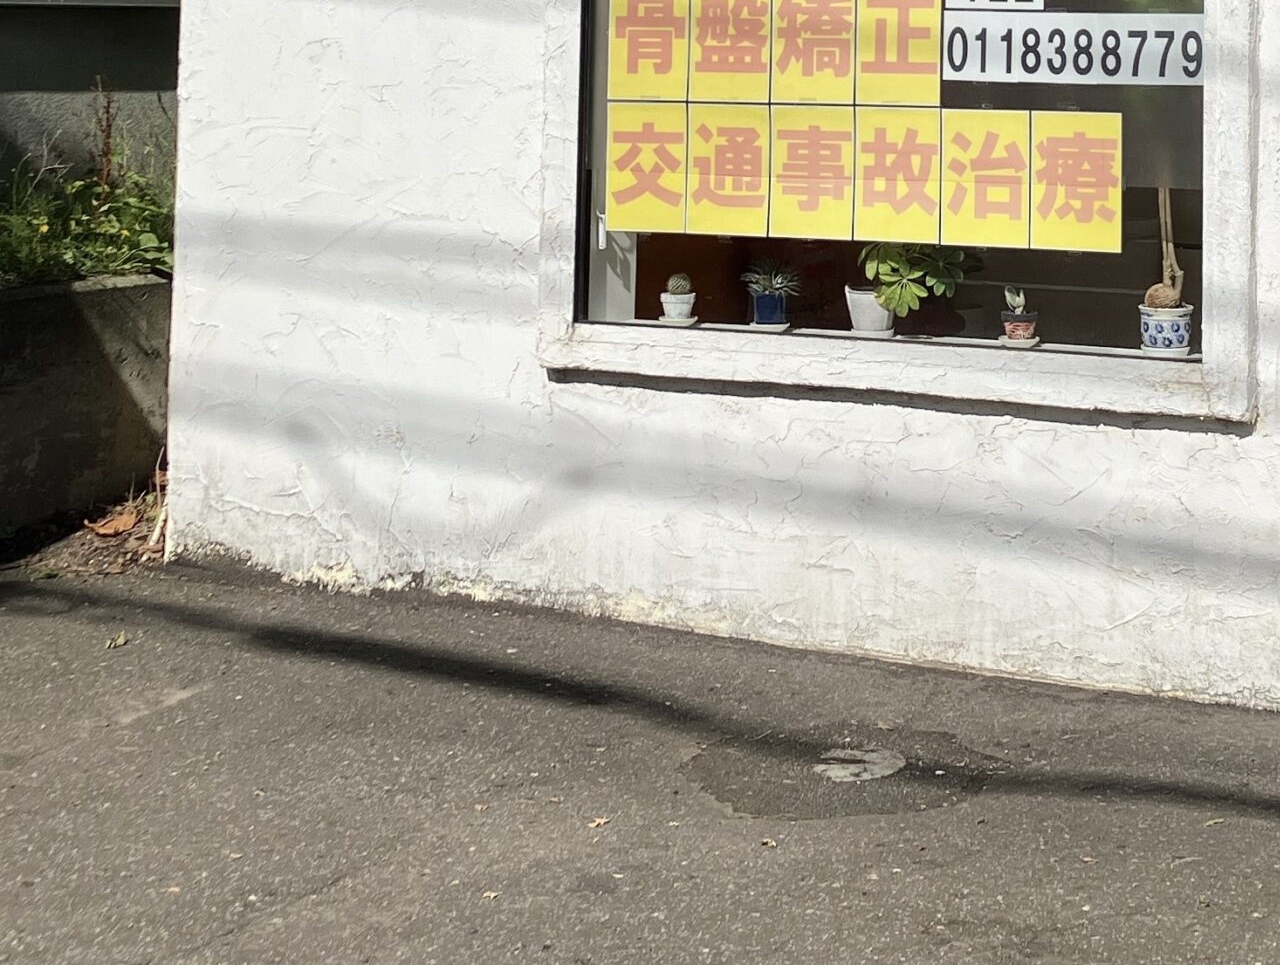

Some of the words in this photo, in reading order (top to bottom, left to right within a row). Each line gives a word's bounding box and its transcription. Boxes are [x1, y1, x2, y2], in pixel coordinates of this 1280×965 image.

[947, 27, 1202, 78] 0118388779
[611, 122, 1119, 223] 交通事故治療
